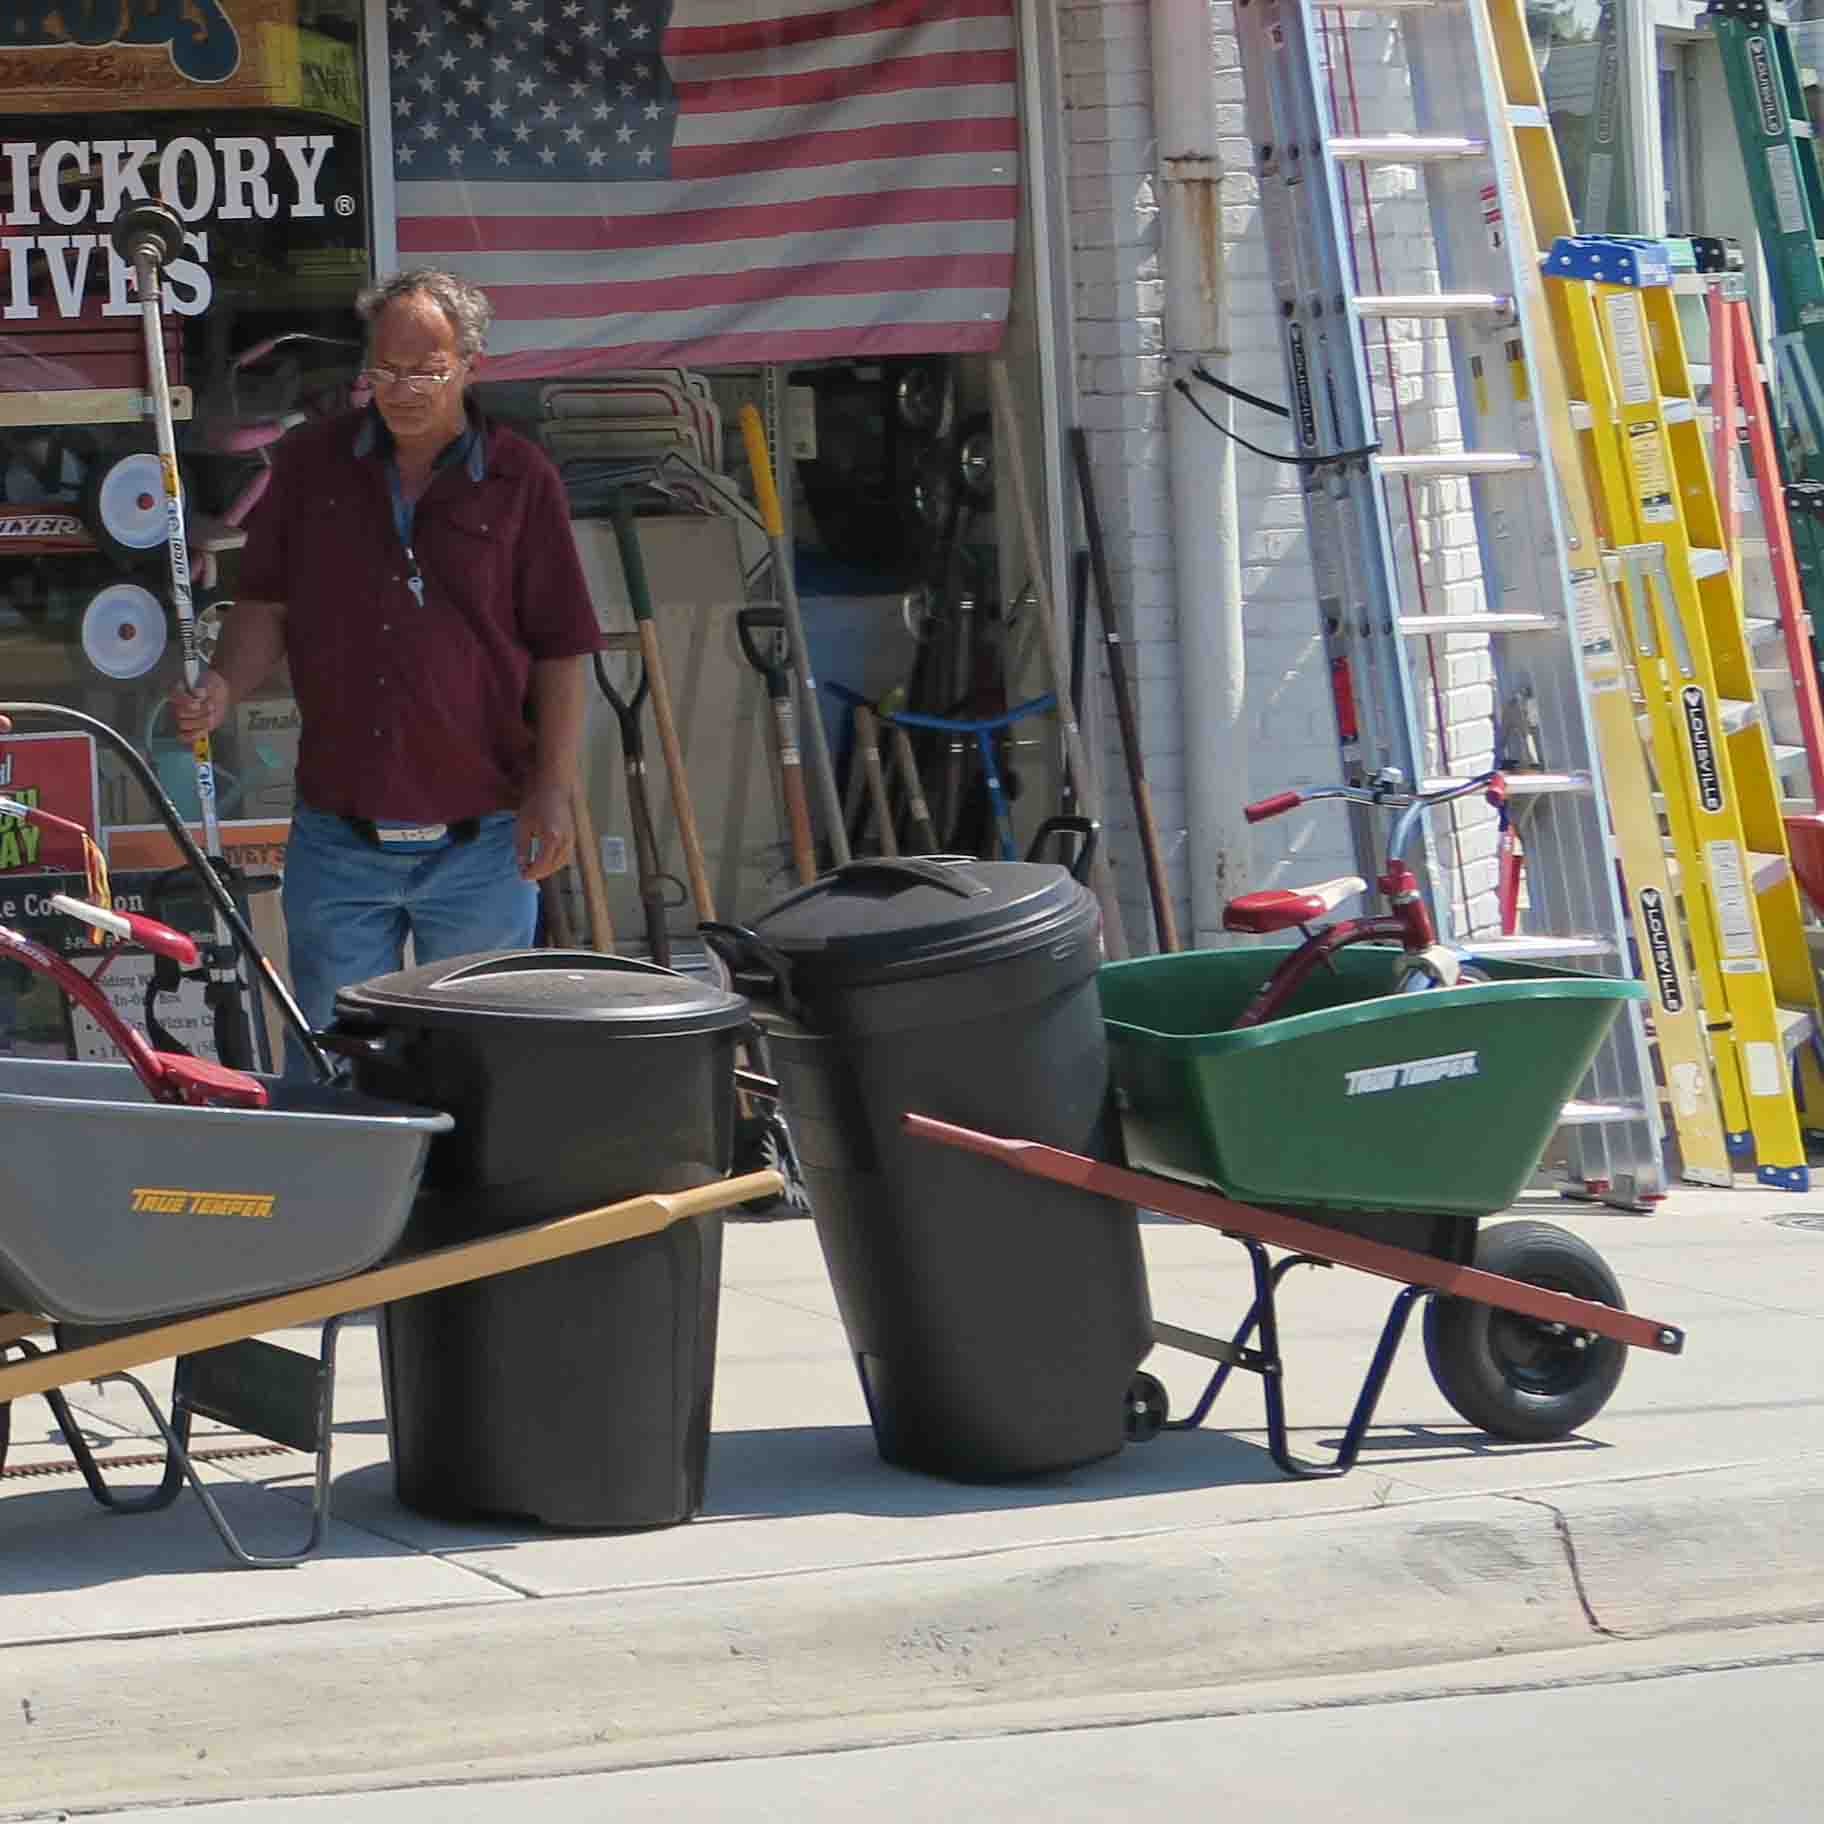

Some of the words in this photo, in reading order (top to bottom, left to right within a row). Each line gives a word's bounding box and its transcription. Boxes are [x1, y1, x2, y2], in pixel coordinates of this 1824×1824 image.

[1689, 707, 1719, 811] LOUISVILLE
[1647, 907, 1679, 1011] LOUISVILLE
[1344, 1064, 1395, 1096] TRUE
[1393, 1051, 1478, 1088] TEMPER
[131, 1187, 185, 1214] TRUE
[189, 1192, 274, 1217] TEMPER
